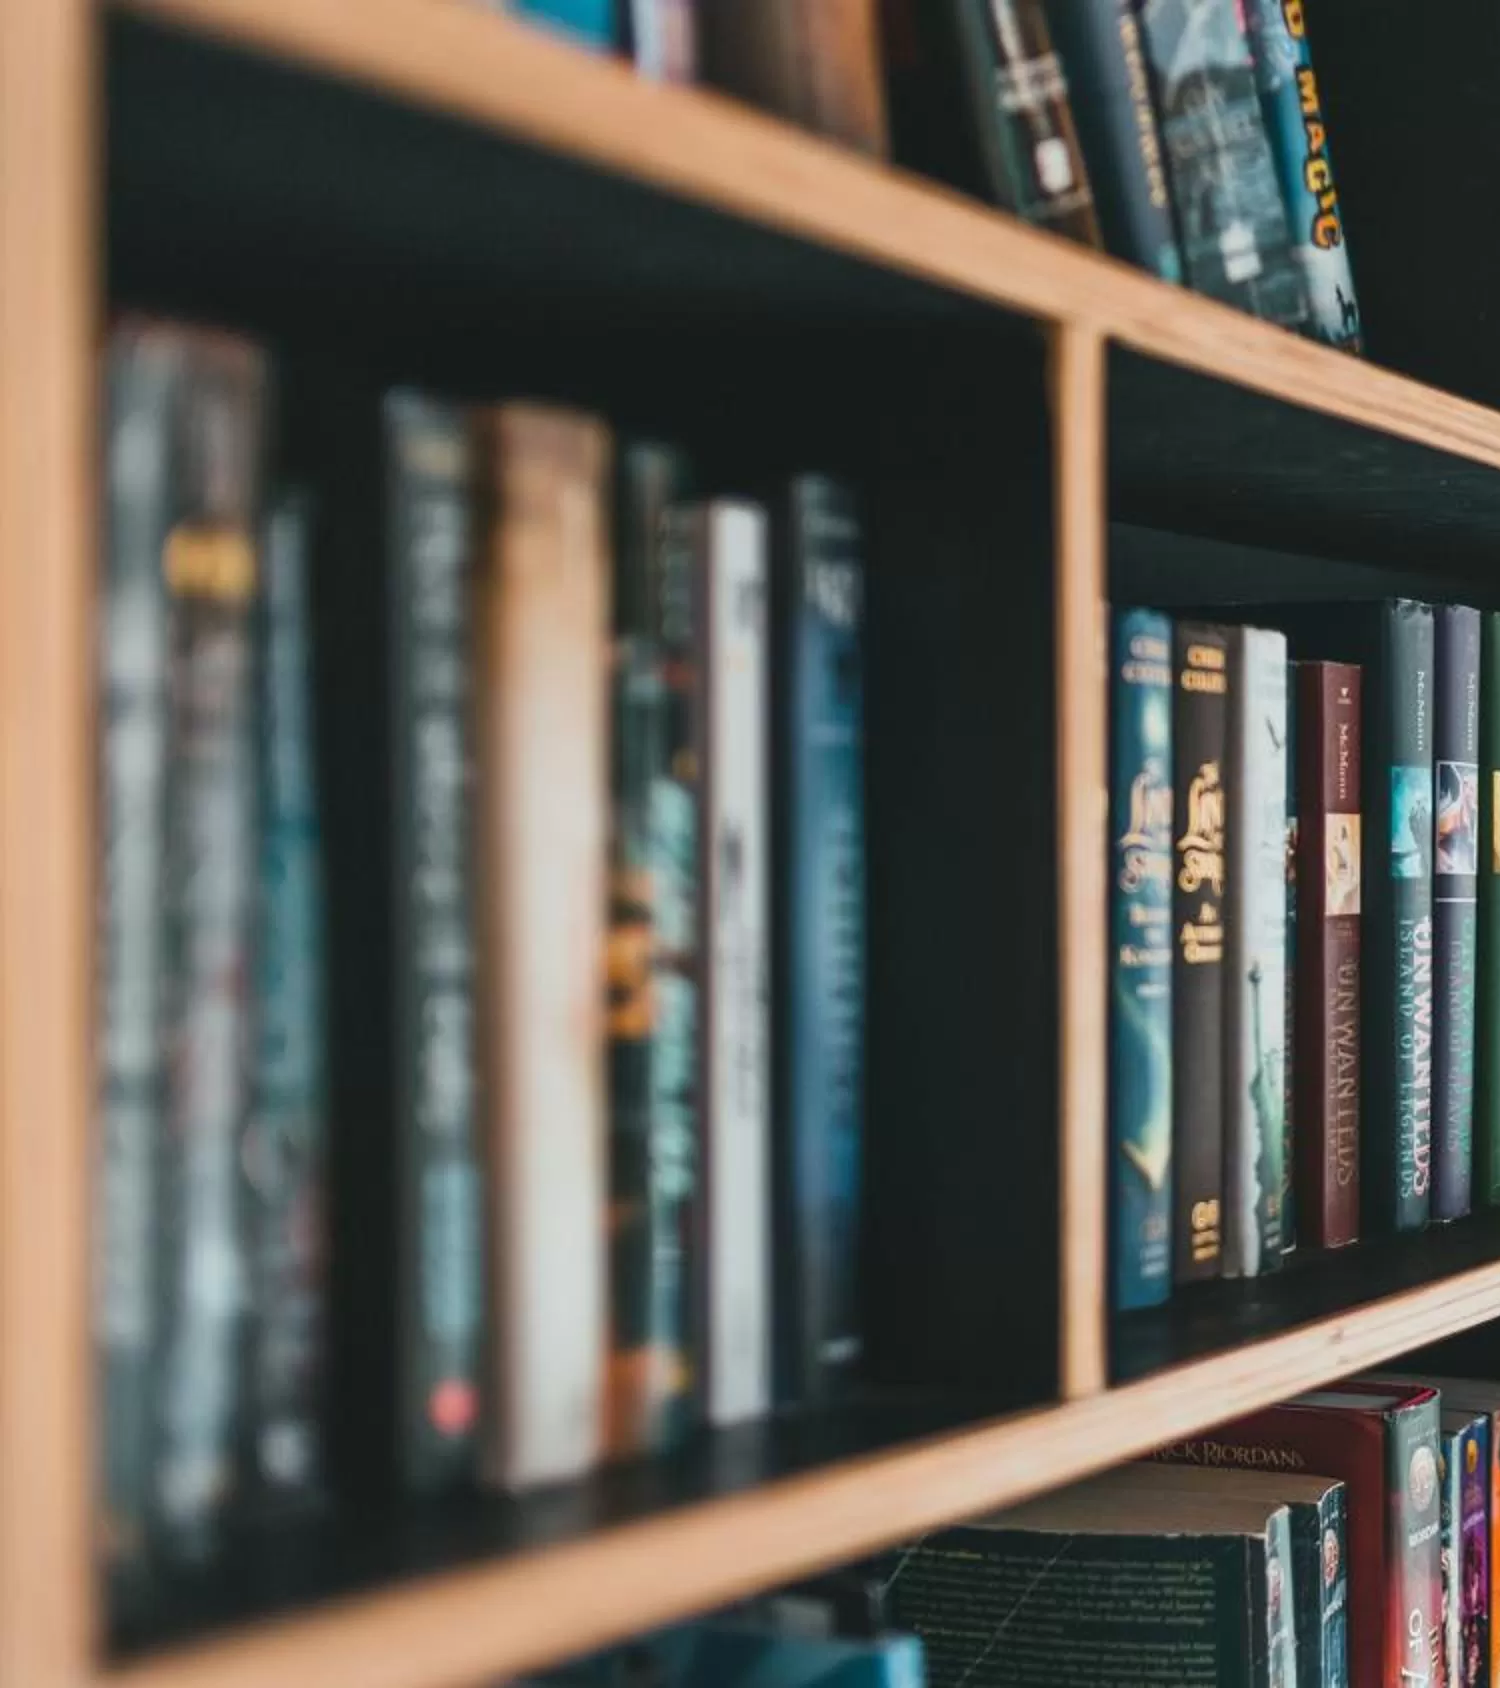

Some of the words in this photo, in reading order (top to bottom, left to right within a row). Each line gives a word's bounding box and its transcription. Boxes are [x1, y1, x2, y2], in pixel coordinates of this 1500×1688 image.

[1296, 66, 1341, 249] MAGIC
[1400, 919, 1415, 1018] ISLAND
[1412, 916, 1432, 1198] UNWANTEDS
[1336, 958, 1358, 1186] UNWANTEDS
[1400, 1082, 1415, 1199] LEGENDS
